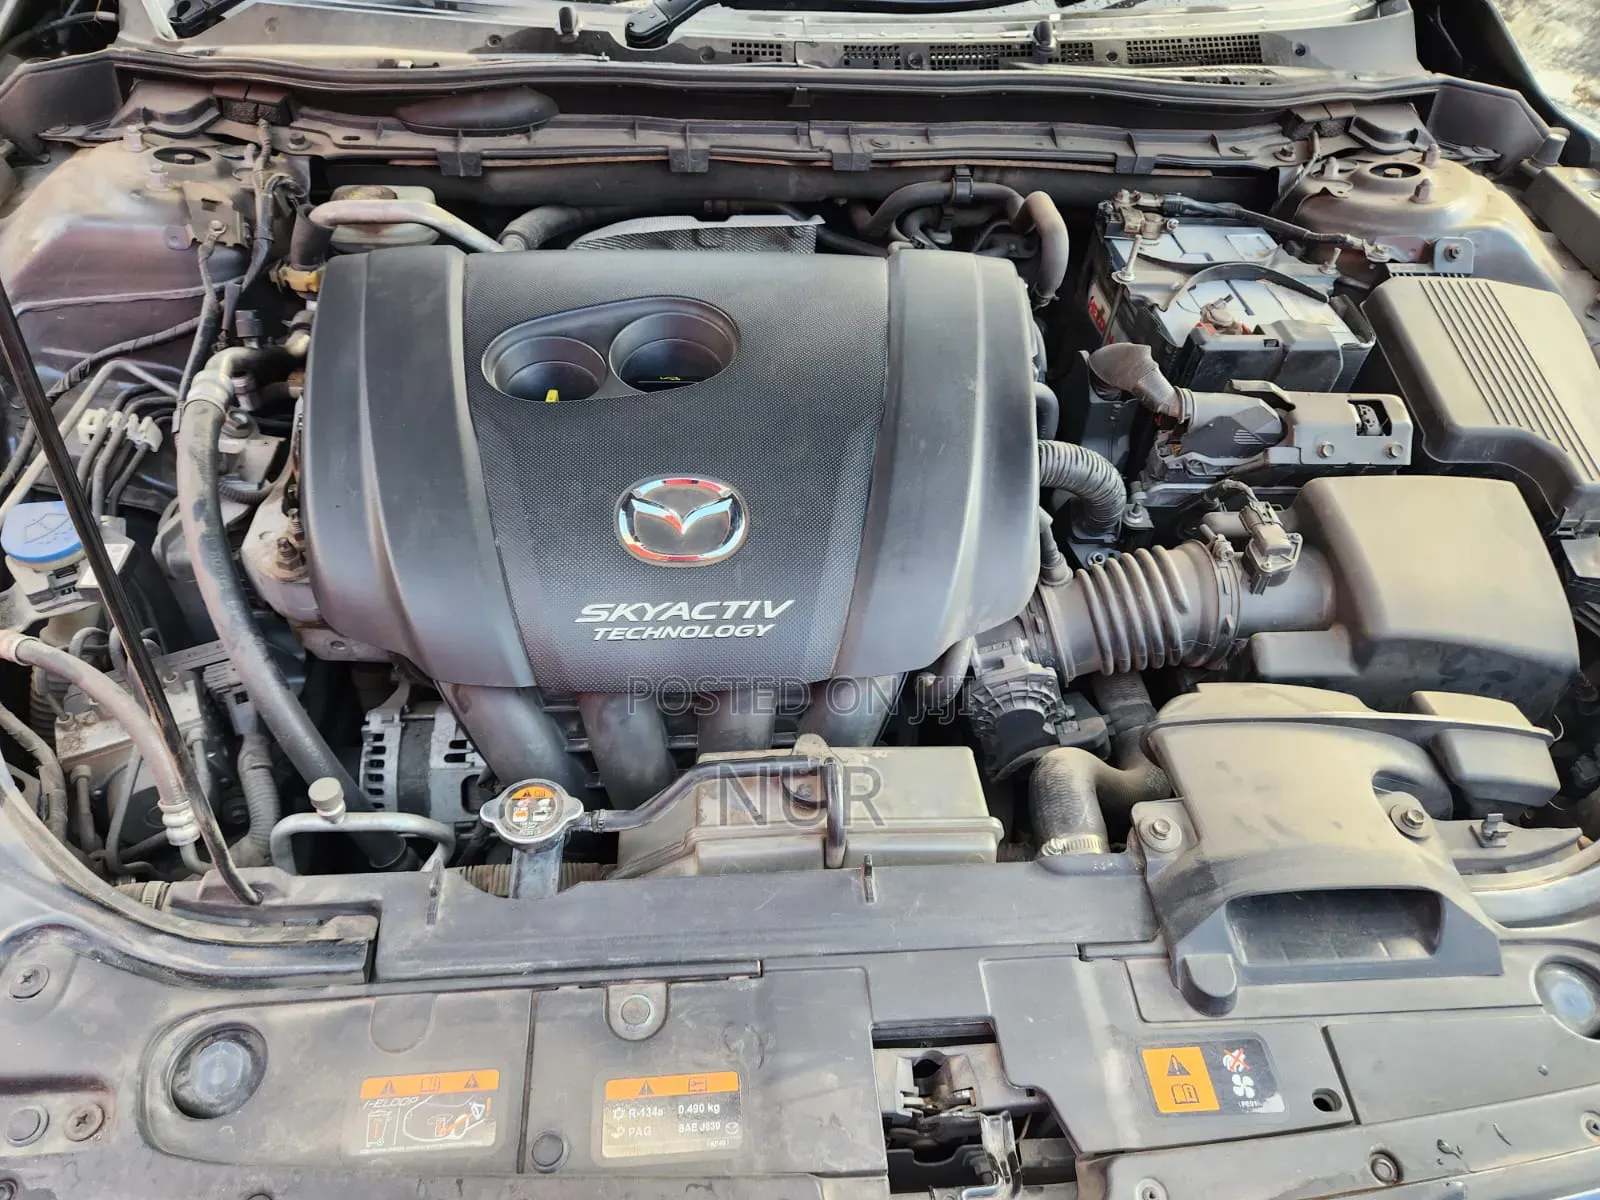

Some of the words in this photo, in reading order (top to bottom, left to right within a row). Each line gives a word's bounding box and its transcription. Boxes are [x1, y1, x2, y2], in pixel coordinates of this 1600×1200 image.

[575, 599, 794, 623] SKYACTIV
[593, 623, 776, 642] TECHNOLOGY
[678, 1103, 705, 1115] 0.490
[707, 1102, 720, 1114] kg
[628, 1126, 652, 1137] PAG
